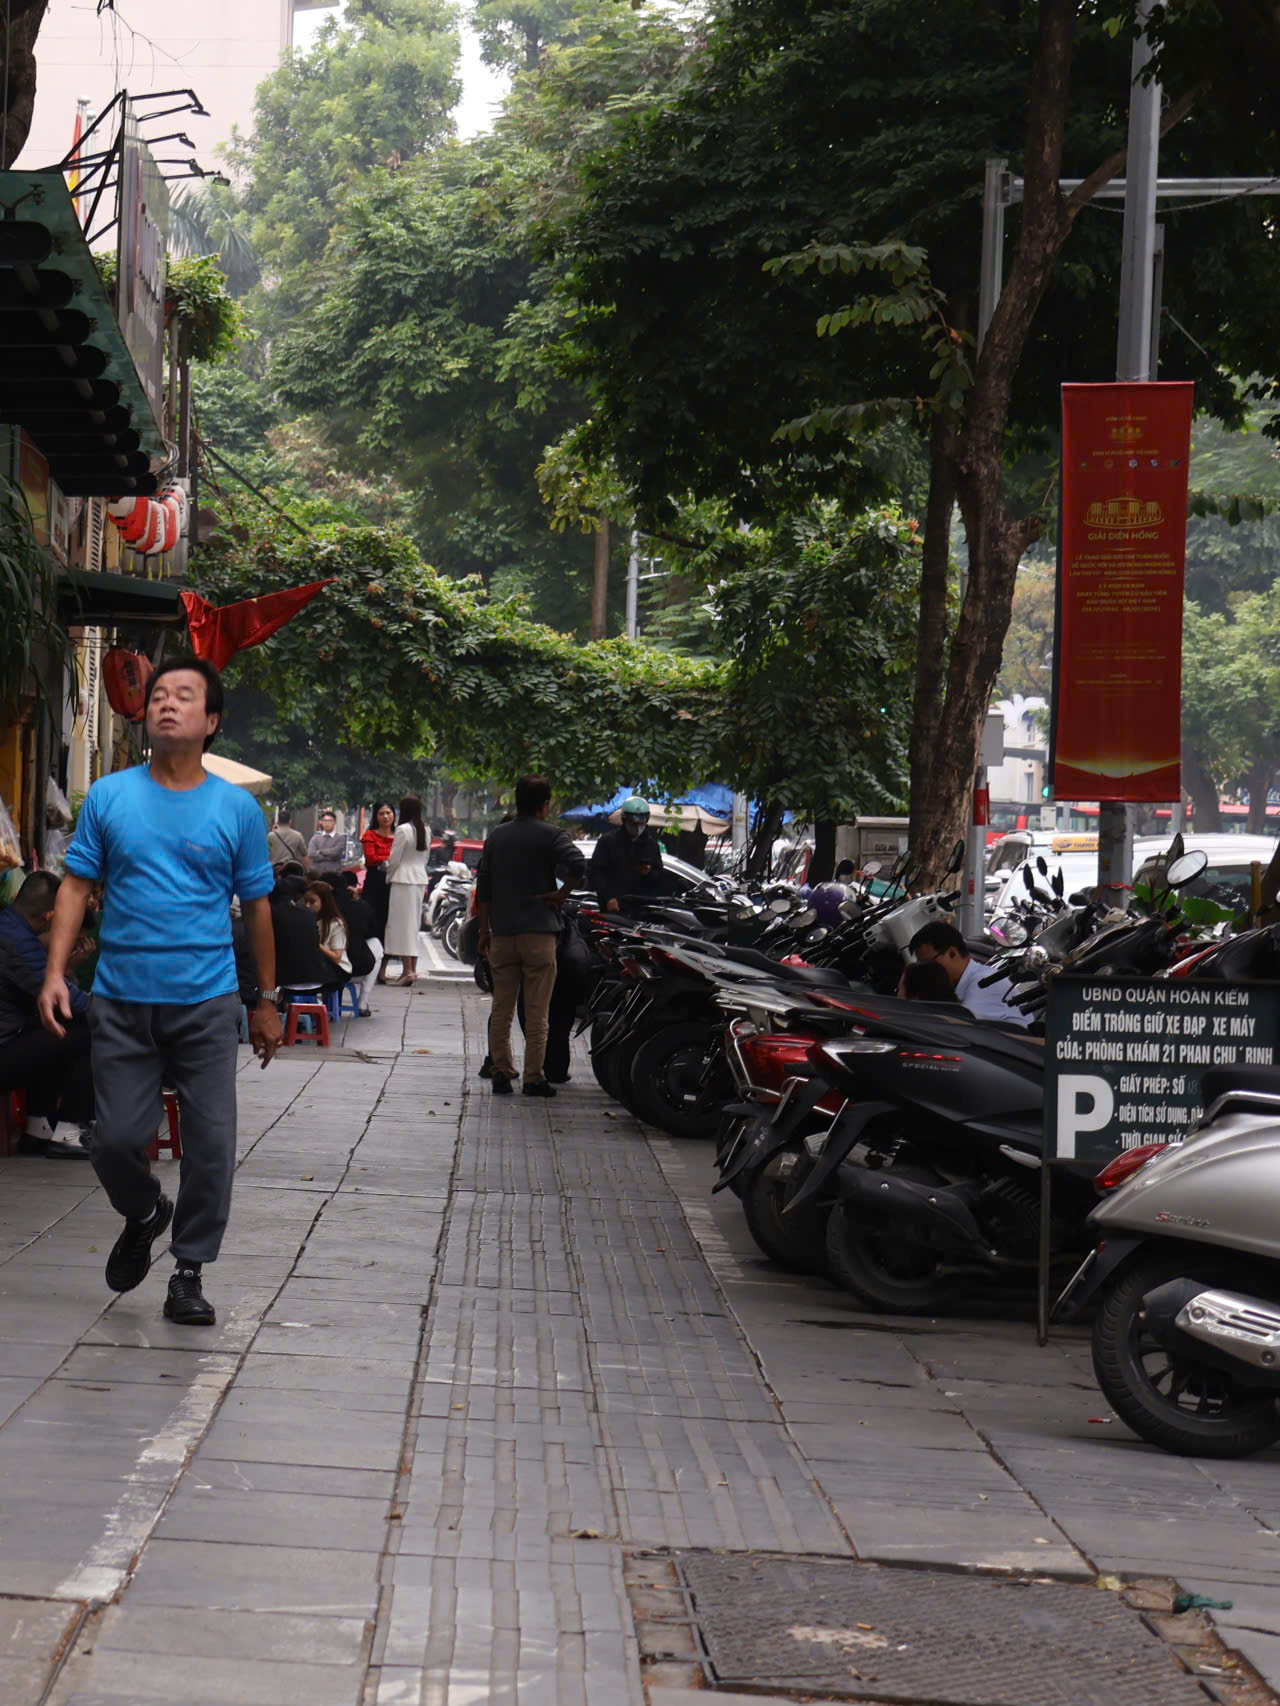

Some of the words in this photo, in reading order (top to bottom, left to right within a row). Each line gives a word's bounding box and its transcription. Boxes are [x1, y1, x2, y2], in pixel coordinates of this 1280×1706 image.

[1082, 987, 1122, 1002] UBND
[1125, 986, 1165, 1005] QUẬN
[1170, 987, 1210, 1005] HOÀN
[1214, 988, 1249, 1006] KIẾM
[1072, 1007, 1101, 1032] ĐIỂM
[1104, 1009, 1141, 1033] TRÔNG
[1144, 1011, 1165, 1034] GIỮ
[1165, 1015, 1180, 1035] XE
[1183, 1015, 1206, 1038] ĐẠP
[1212, 1016, 1227, 1037] XE
[1230, 1013, 1256, 1037] MÁY
[1056, 1034, 1082, 1060] CỦA:
[1085, 1038, 1124, 1062] PHÒNG
[1126, 1040, 1160, 1063] KHÁM
[1162, 1044, 1176, 1063] 21
[1179, 1044, 1210, 1065] PHAN
[1213, 1045, 1237, 1065] CHU
[1120, 1073, 1141, 1093] GIẤY
[1142, 1075, 1170, 1095] PHÉP:
[1171, 1075, 1187, 1096] SỐ
[1056, 1073, 1114, 1159] P
[1119, 1102, 1136, 1124] DIỆN
[1138, 1103, 1155, 1123] TÍCH
[1155, 1101, 1167, 1124] SỬ
